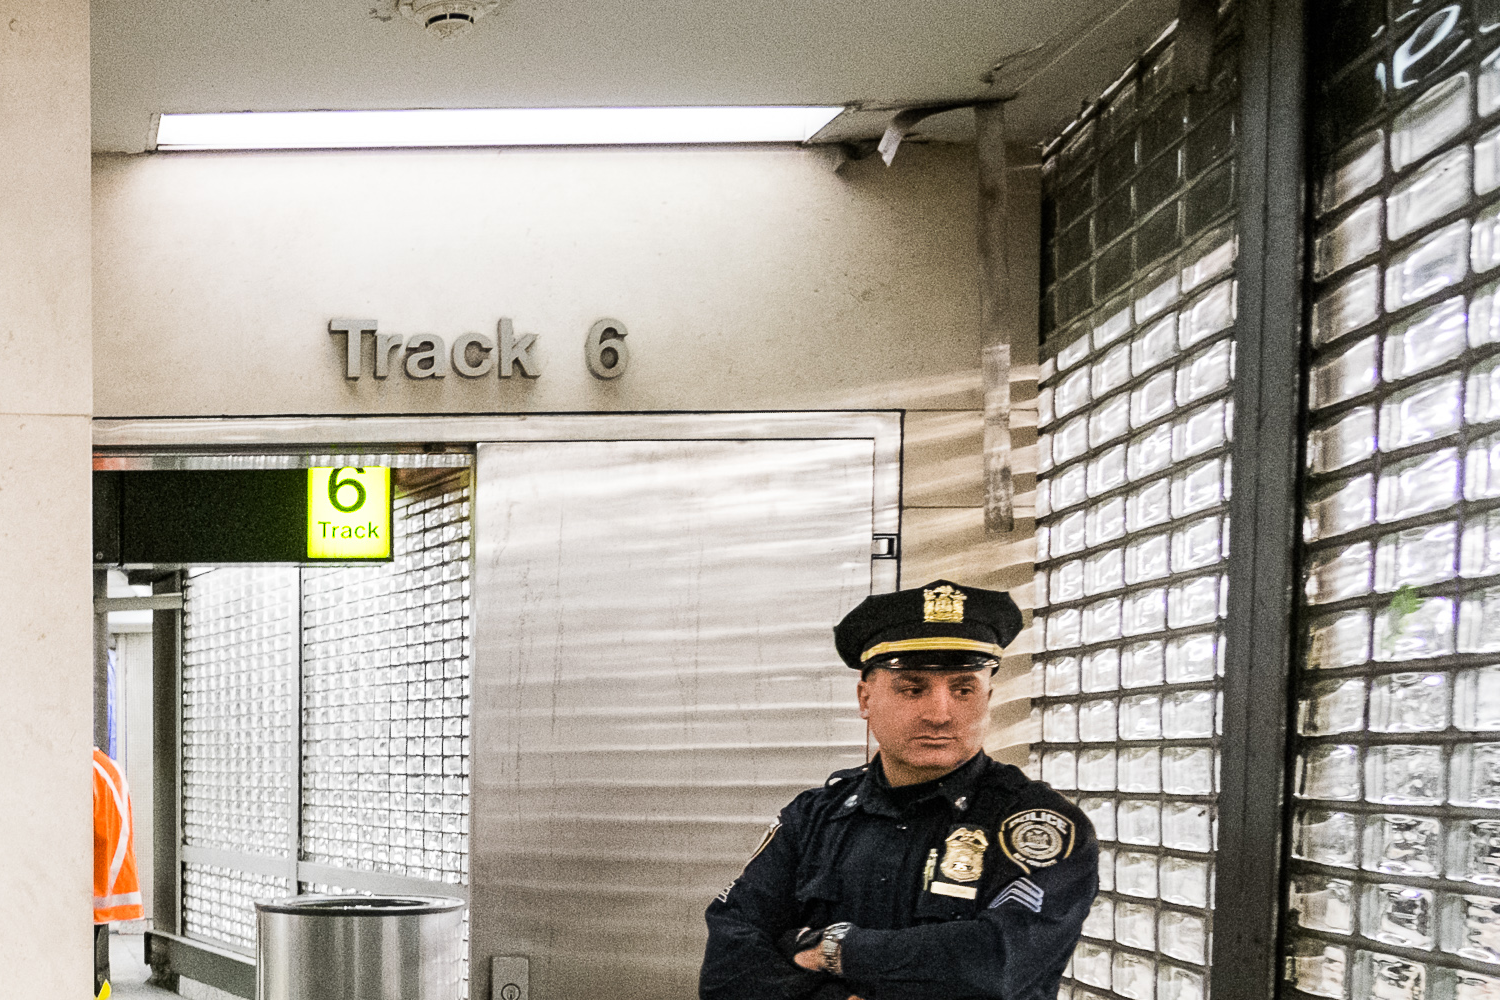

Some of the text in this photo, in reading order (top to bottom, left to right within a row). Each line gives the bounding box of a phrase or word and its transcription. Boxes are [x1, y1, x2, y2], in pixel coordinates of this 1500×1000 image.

[328, 317, 629, 381] Track 6
[328, 466, 366, 513] 6
[318, 521, 379, 539] Track
[1008, 811, 1068, 835] POLICE
